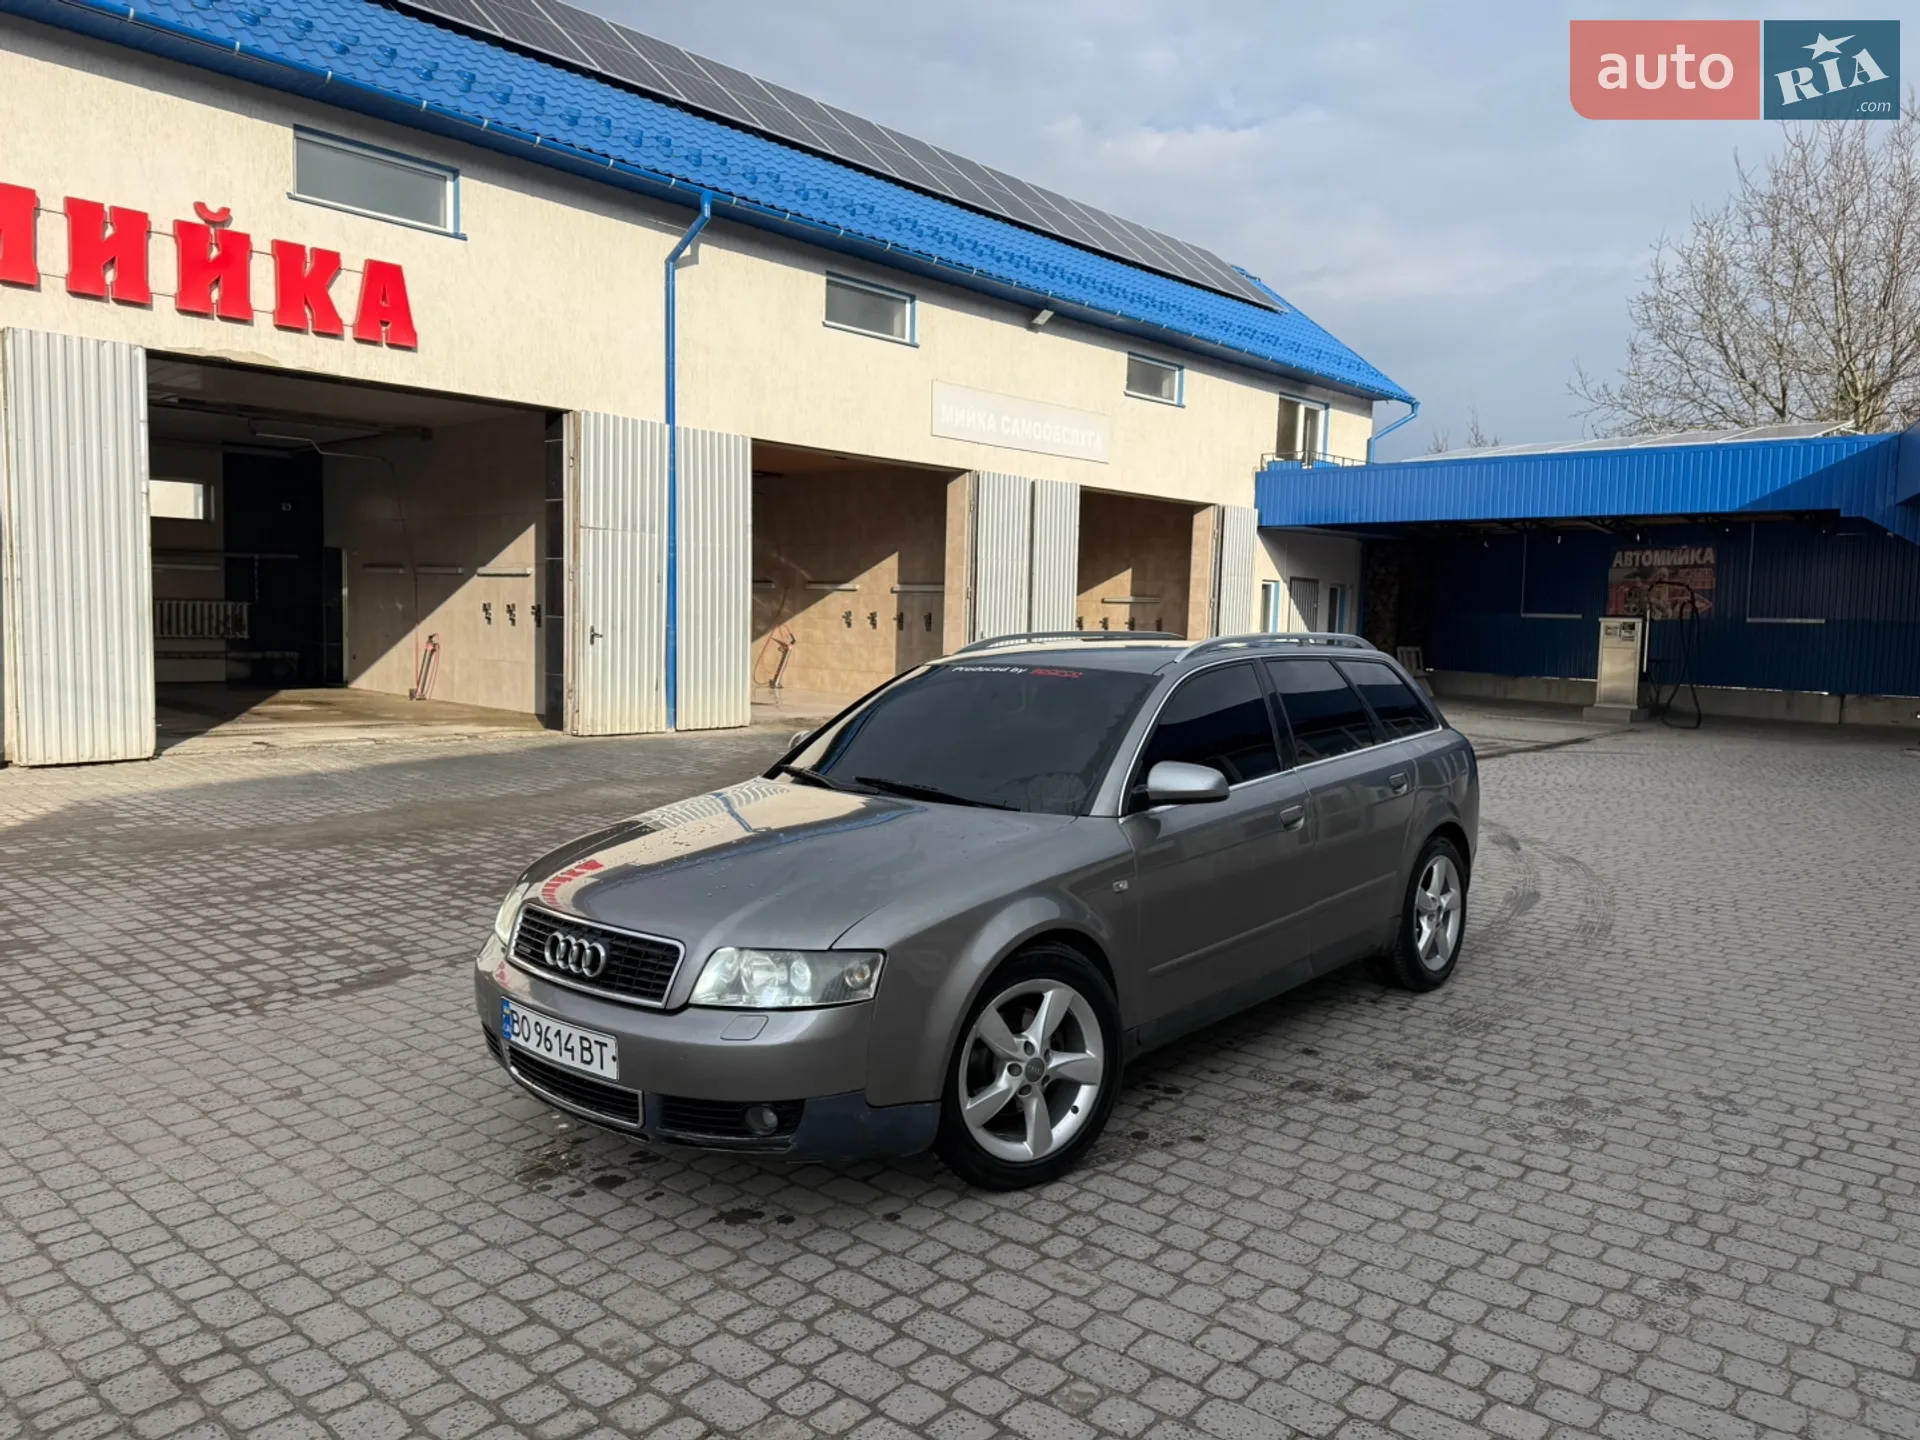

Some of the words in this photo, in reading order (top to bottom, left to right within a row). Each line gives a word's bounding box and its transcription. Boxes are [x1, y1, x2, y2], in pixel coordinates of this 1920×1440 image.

[942, 404, 997, 433] МИЙКА
[1001, 415, 1103, 448] САМООБСЛУГА
[1612, 545, 1716, 568] АВТОМИЙКА
